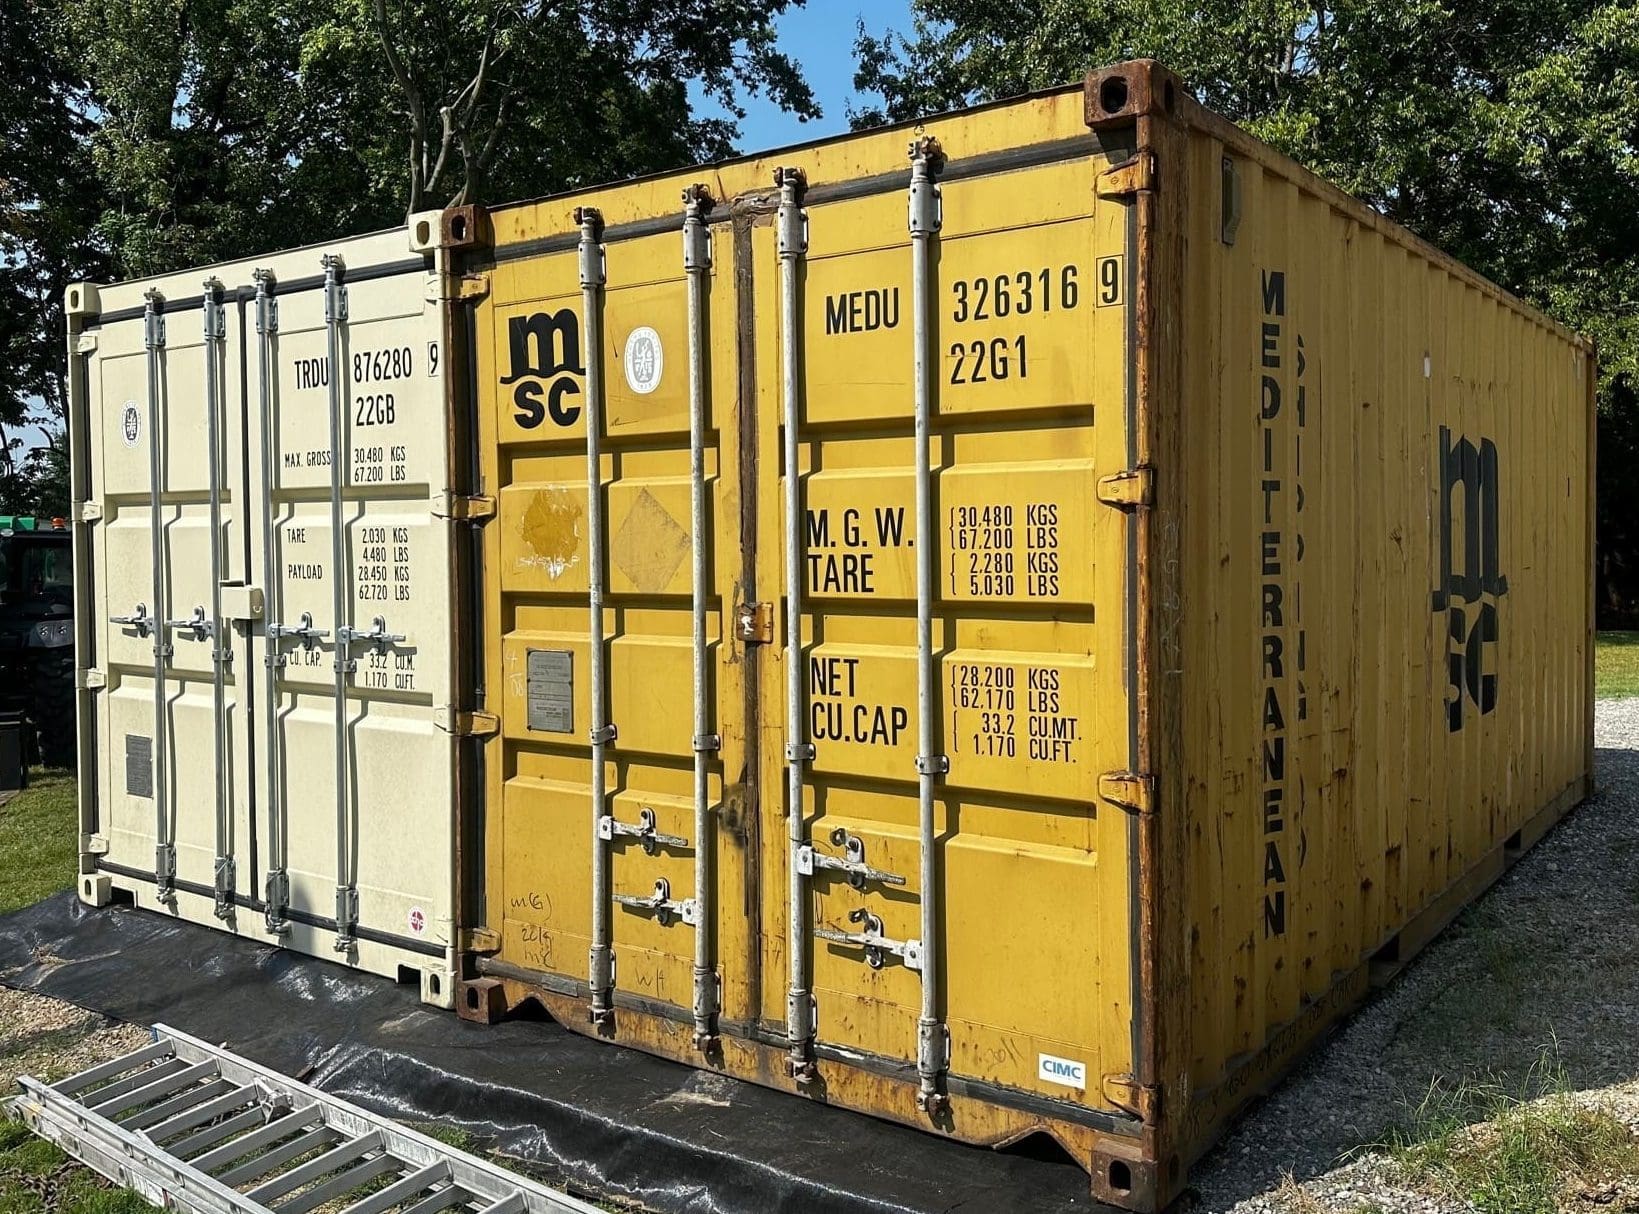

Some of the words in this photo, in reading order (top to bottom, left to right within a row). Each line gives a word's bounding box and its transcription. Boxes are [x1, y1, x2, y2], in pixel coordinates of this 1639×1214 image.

[825, 287, 899, 336] MEDU
[952, 264, 1078, 323] 326316
[1101, 258, 1119, 304] 9
[294, 356, 329, 390] TRDU
[353, 346, 413, 384] 876280
[429, 343, 439, 375] 9
[950, 334, 1027, 385] 22G1
[355, 393, 396, 427] 22GB
[306, 450, 331, 467] GROSS
[390, 445, 406, 462] KGS
[390, 464, 406, 481] LBS
[1026, 504, 1058, 526] KGS
[287, 528, 306, 544] TARE
[393, 527, 409, 544] KGS
[1027, 527, 1058, 549] LBS
[394, 547, 409, 563] LBS
[288, 564, 323, 580] PAYLOAD
[394, 565, 410, 582] KGS
[808, 553, 875, 593] TARE
[1027, 552, 1059, 574] KGS
[394, 585, 410, 601] LBS
[1028, 575, 1059, 597] LBS
[1261, 268, 1286, 940] MEDITERRANEAN
[811, 657, 859, 697] NET
[1028, 667, 1060, 691] KGS
[1028, 690, 1060, 714] LBS
[981, 712, 1015, 736] 33.2
[1042, 1059, 1081, 1080] CIMC
